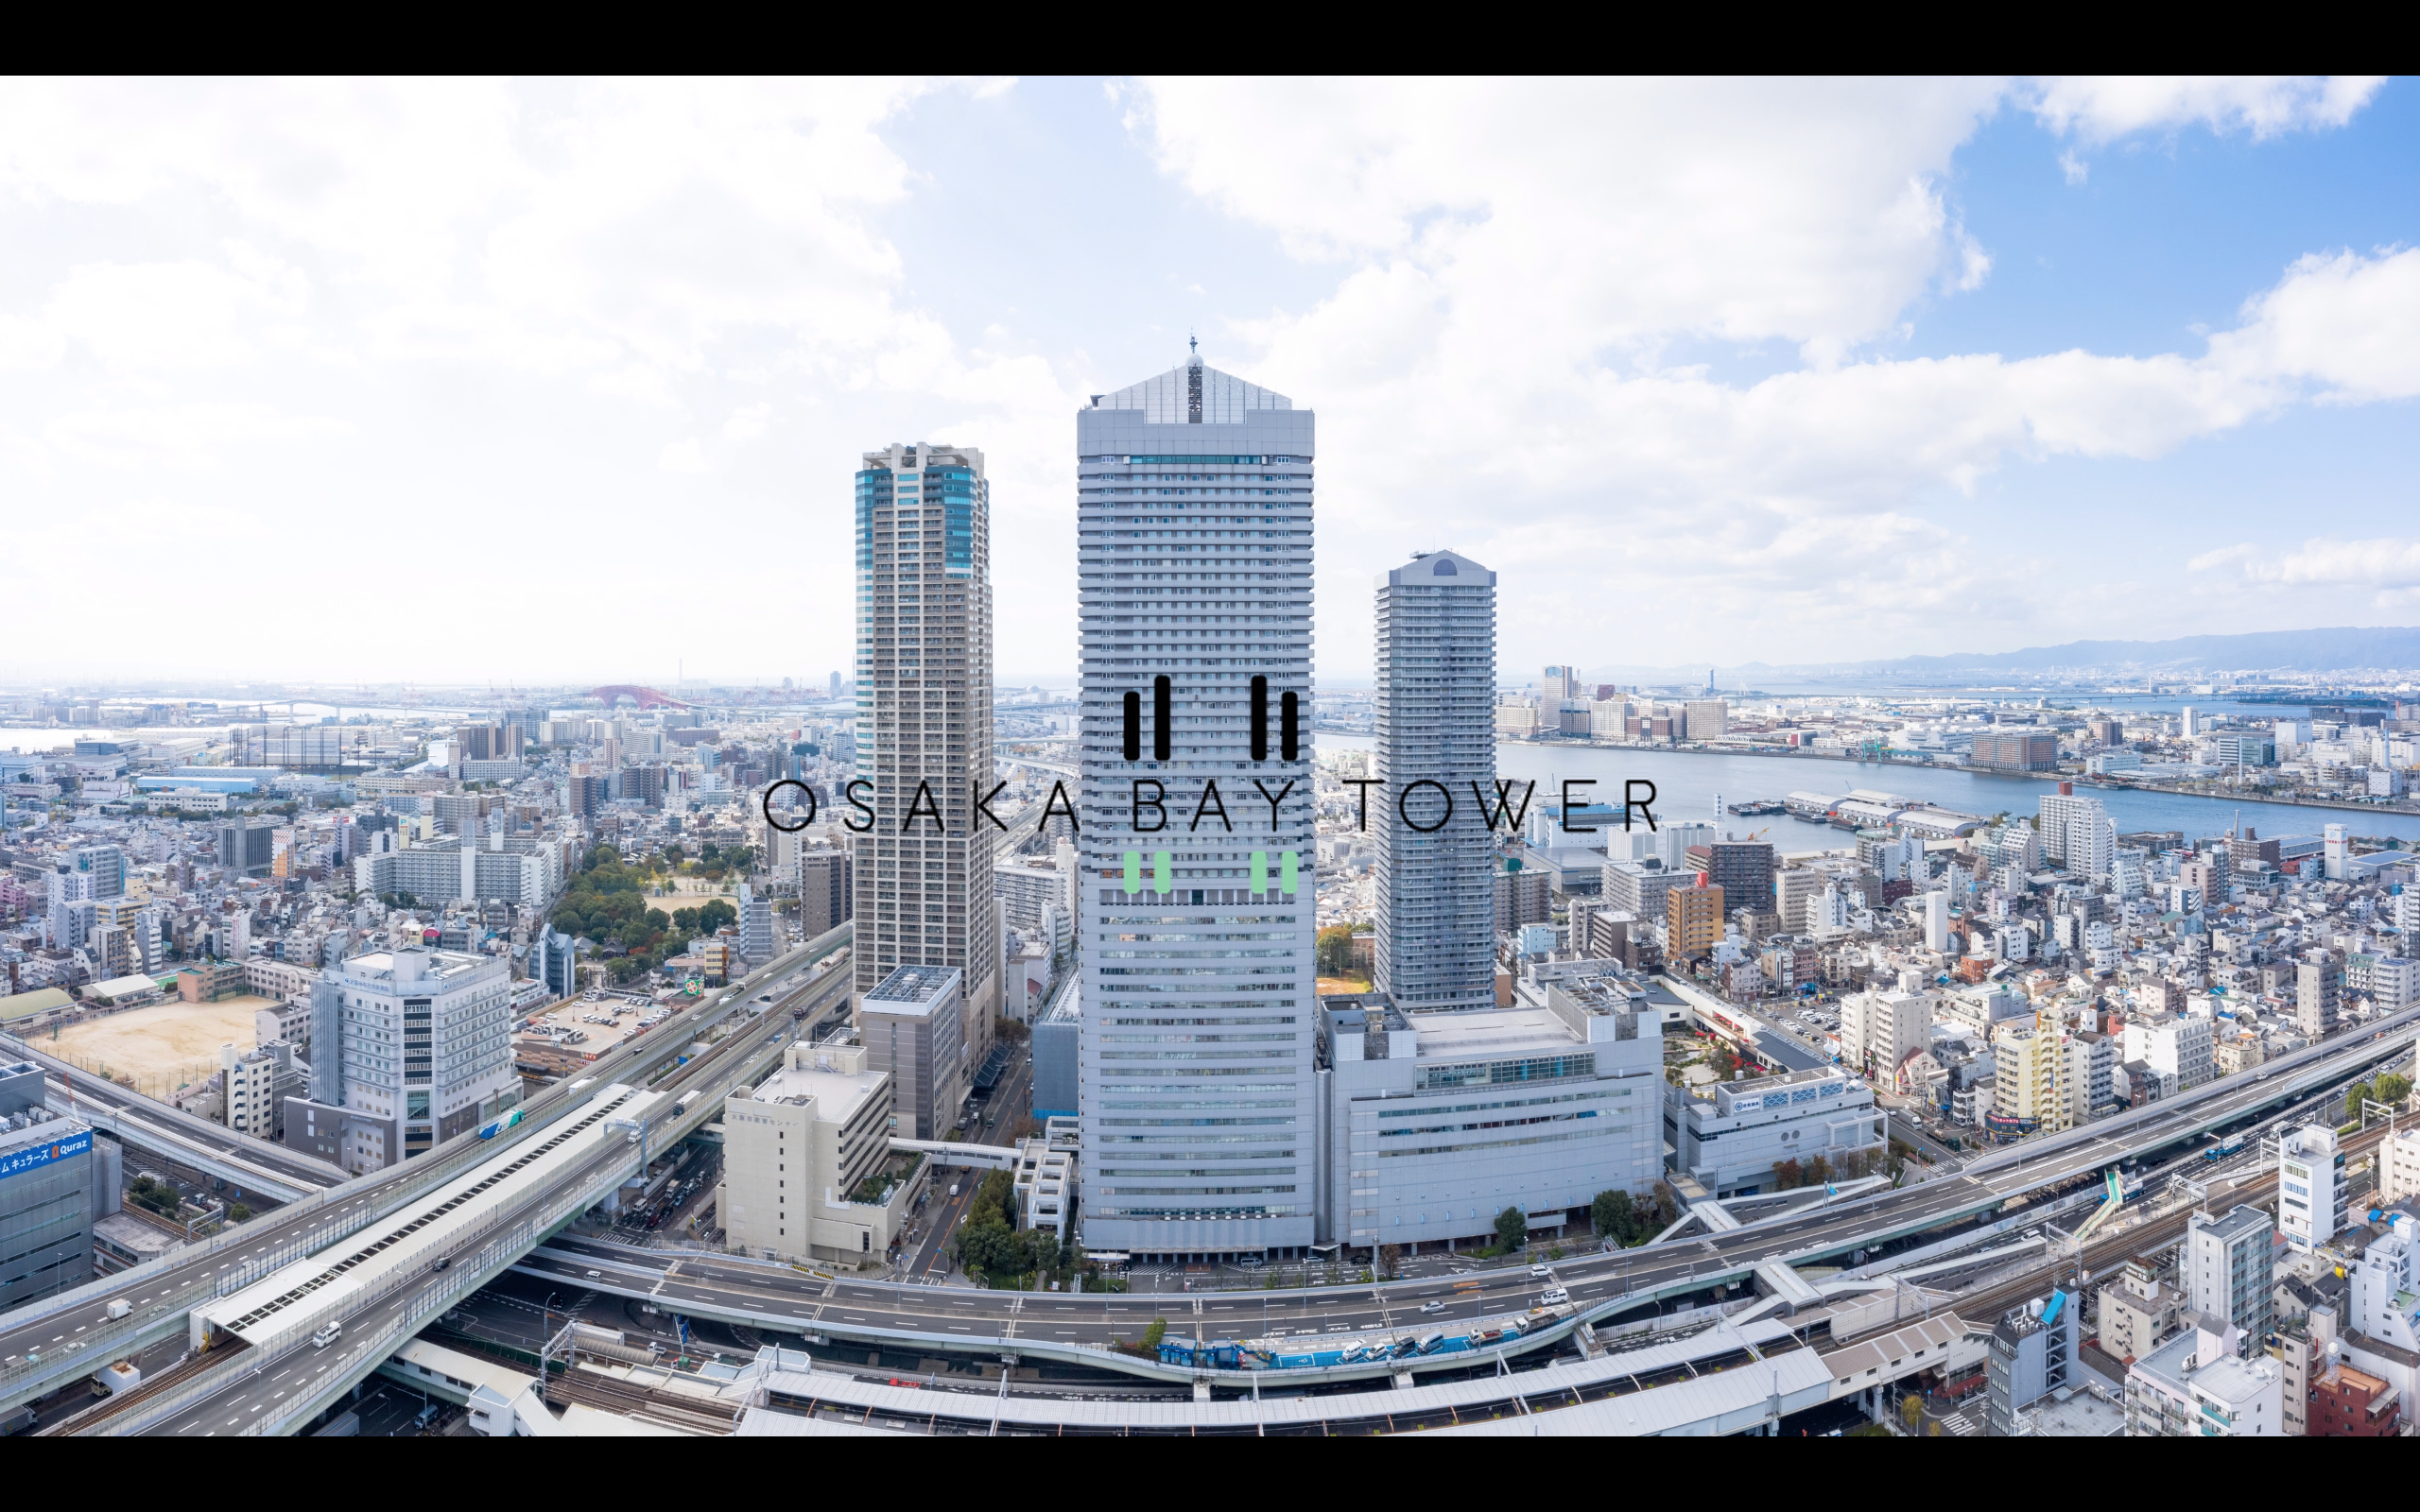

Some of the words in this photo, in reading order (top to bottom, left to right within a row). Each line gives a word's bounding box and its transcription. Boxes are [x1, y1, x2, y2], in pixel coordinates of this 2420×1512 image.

[11, 1148, 49, 1170] キュラーズ
[60, 1140, 87, 1155] Quraz
